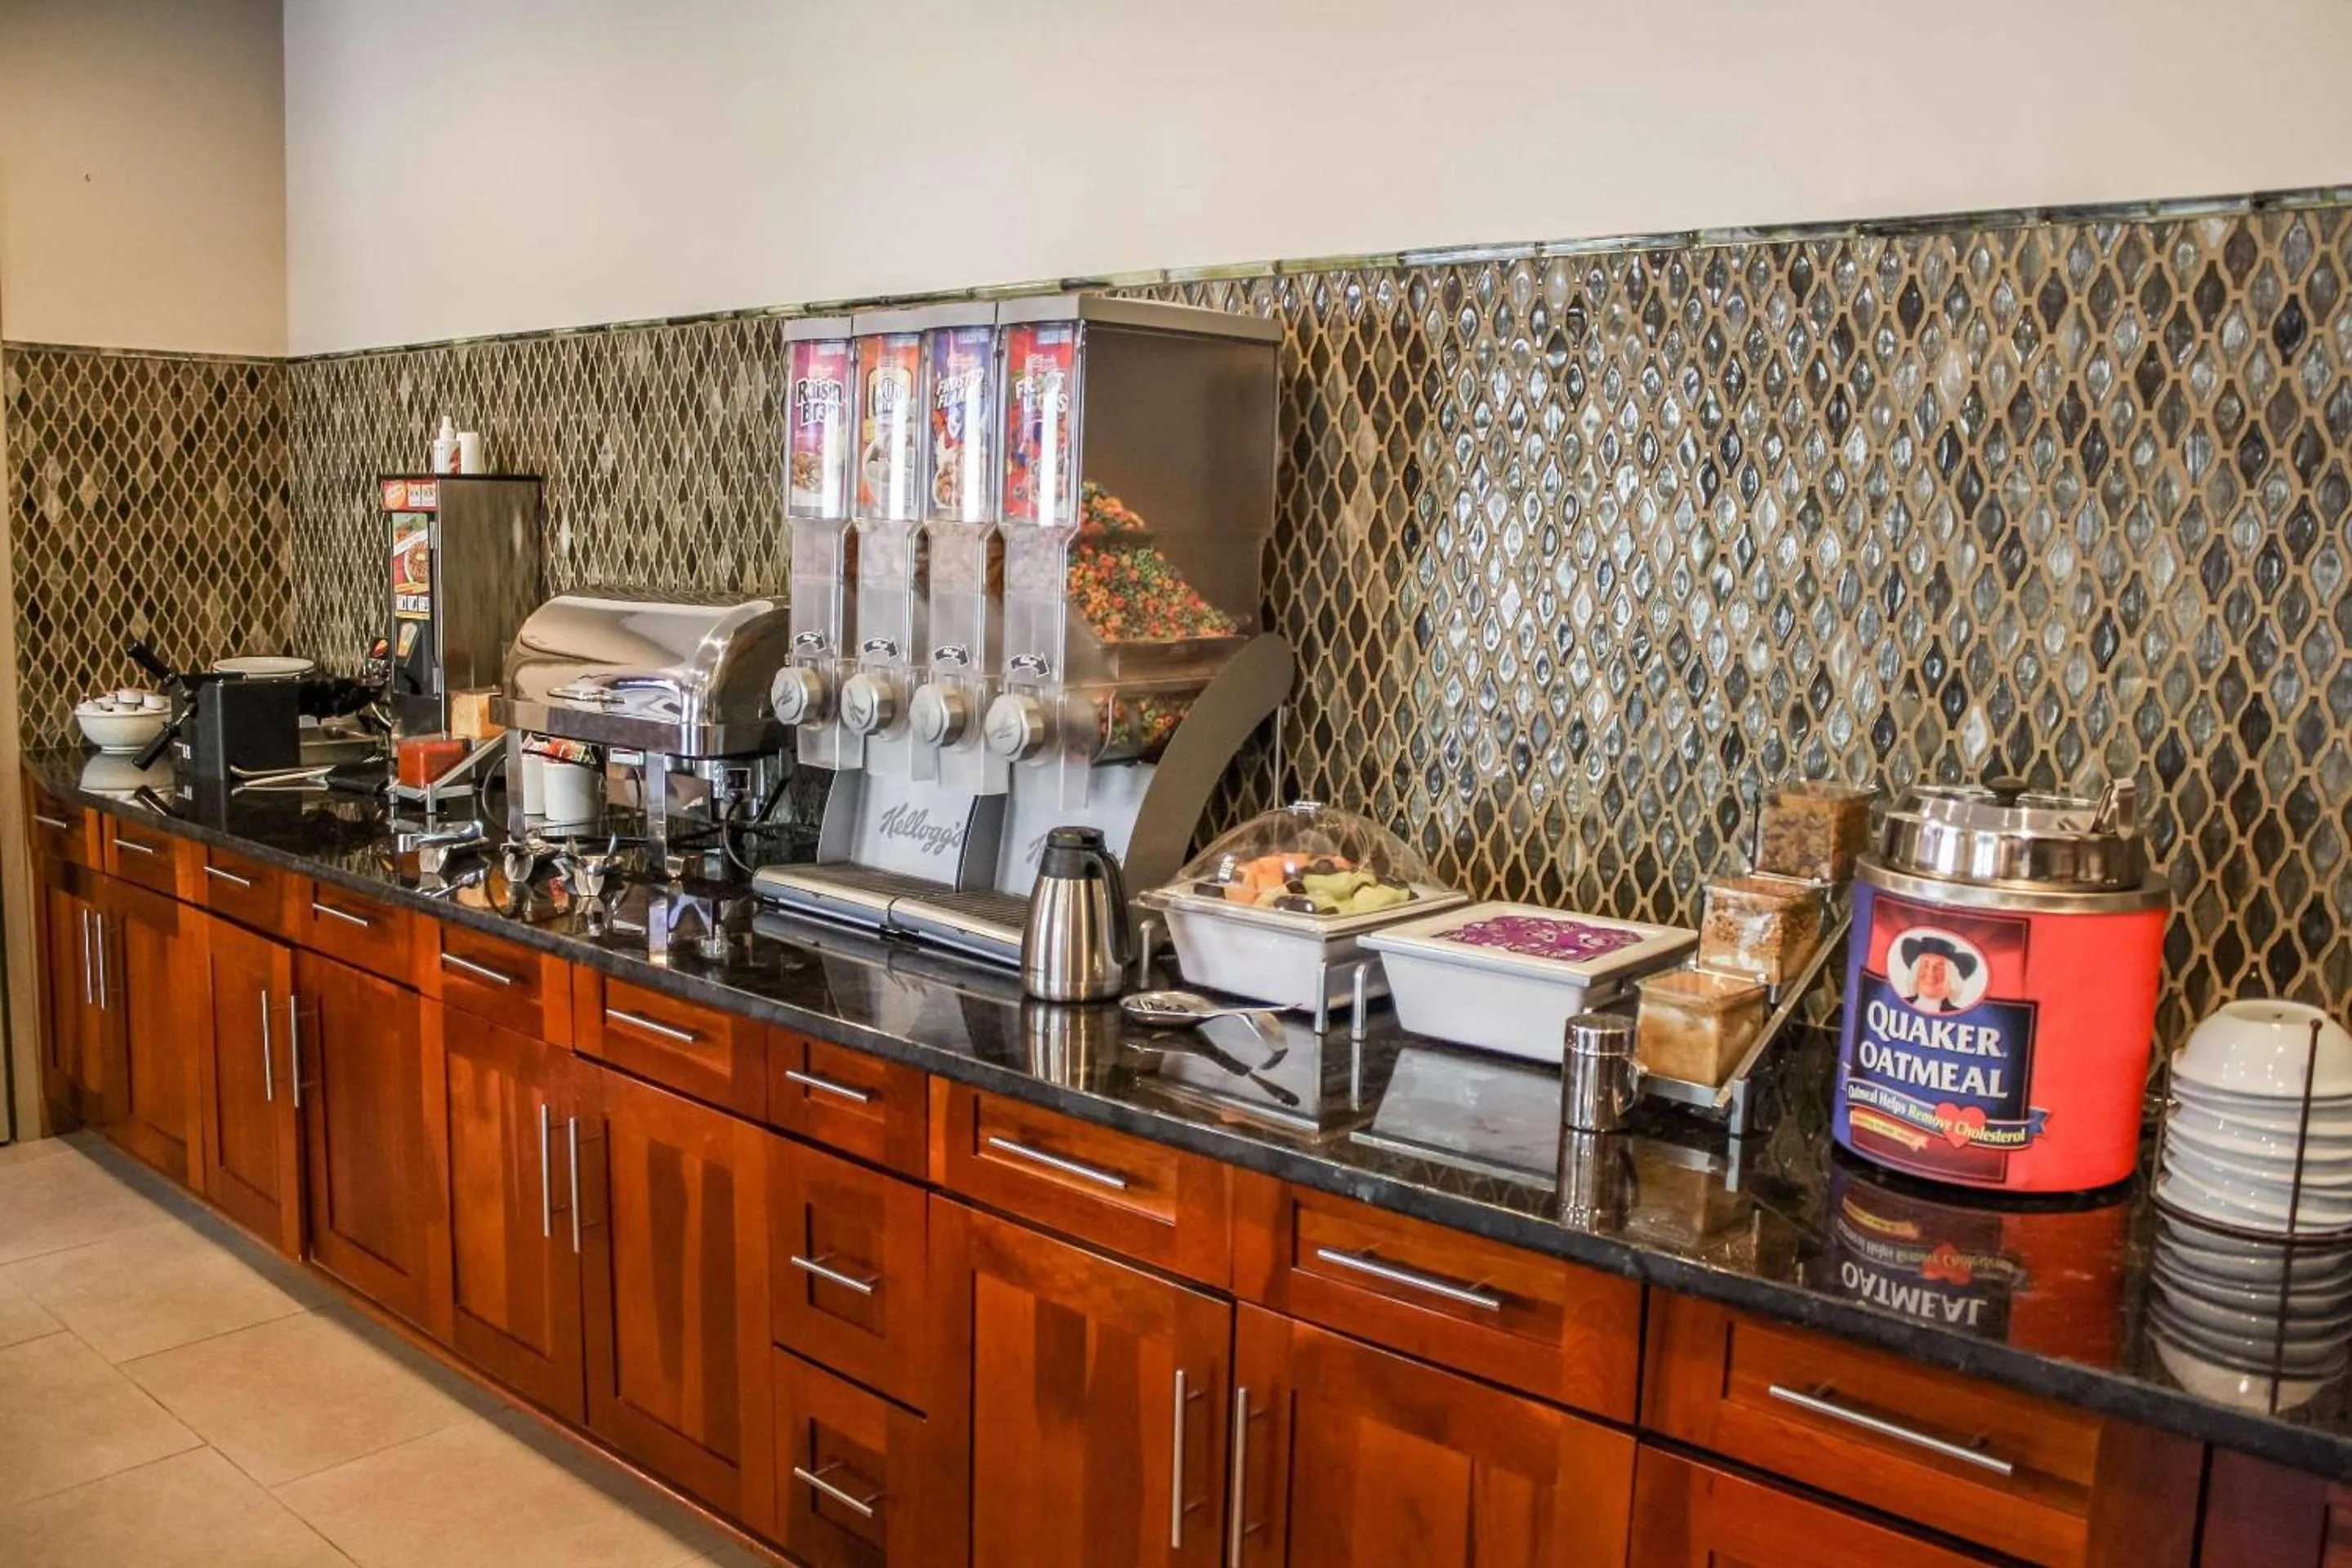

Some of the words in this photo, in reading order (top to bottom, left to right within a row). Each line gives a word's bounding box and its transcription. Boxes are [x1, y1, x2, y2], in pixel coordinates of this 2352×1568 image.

[796, 379, 842, 404] Raisin
[879, 802, 964, 855] Kellogg's
[1867, 1000, 2006, 1058] QUAKER
[1859, 1040, 2009, 1099] OATMEAL
[1879, 1090, 1906, 1115] Helps
[1908, 1103, 1952, 1132] Remove
[1954, 1120, 2026, 1144] Cholesterol
